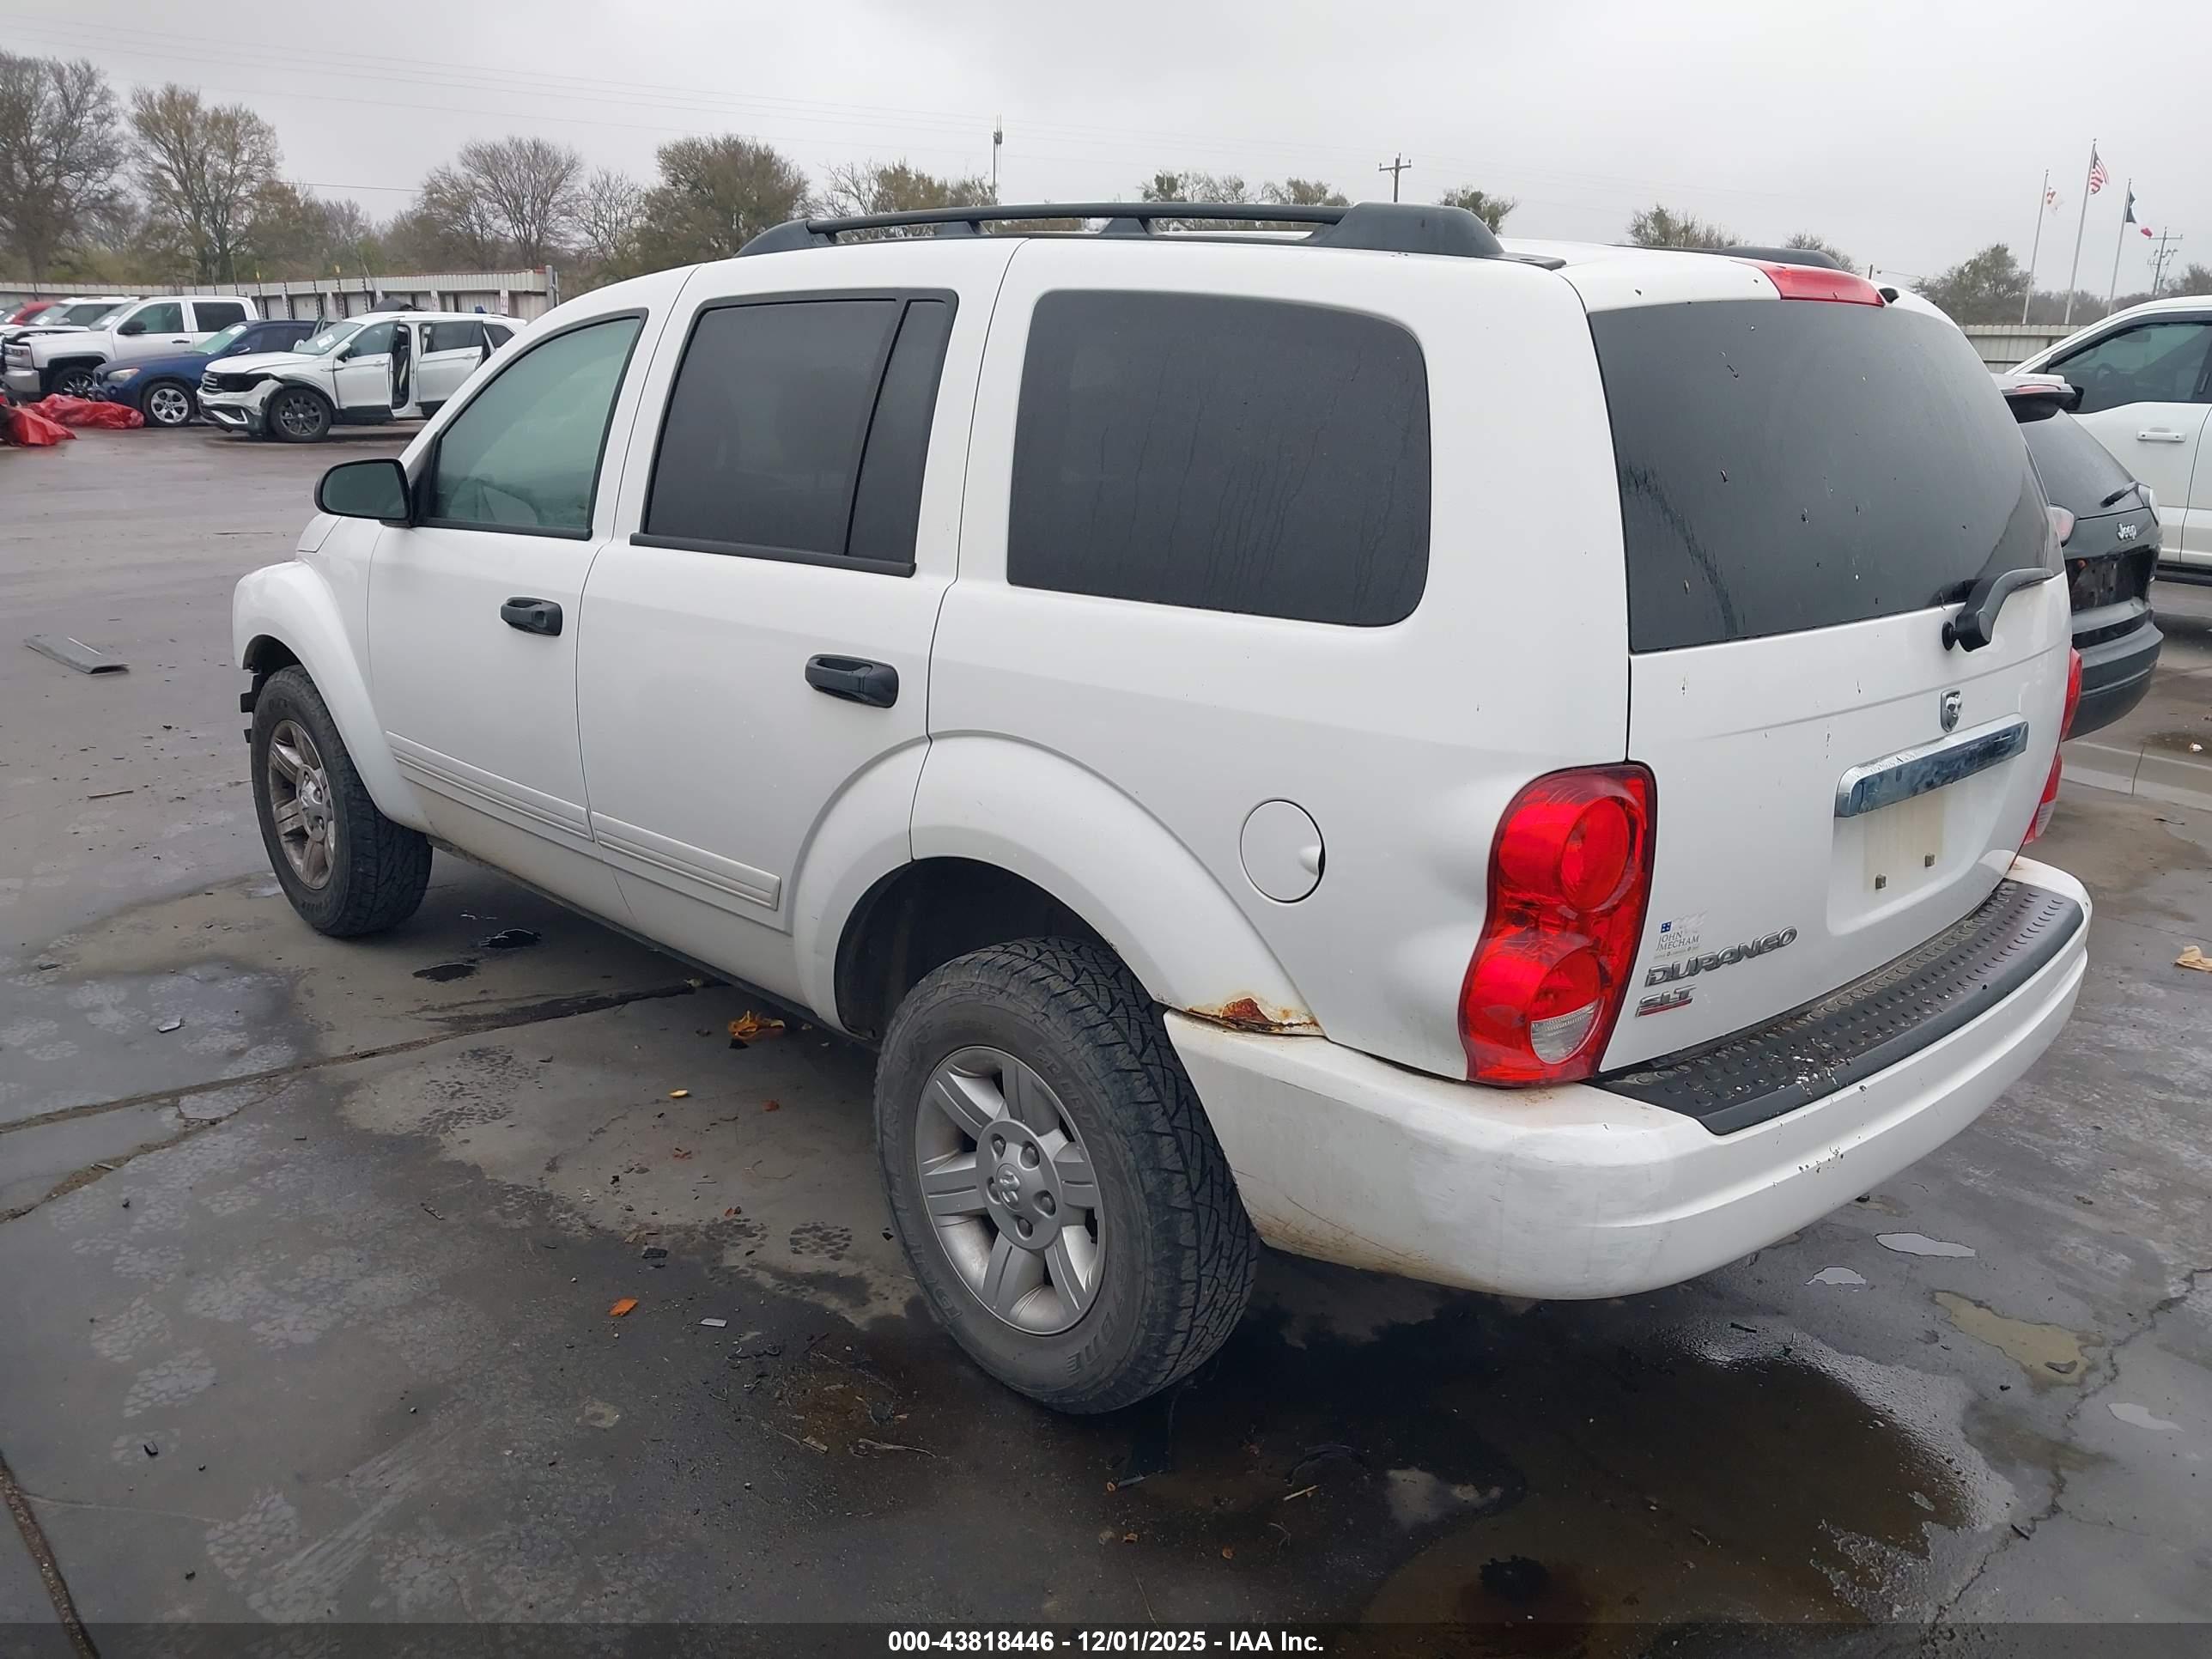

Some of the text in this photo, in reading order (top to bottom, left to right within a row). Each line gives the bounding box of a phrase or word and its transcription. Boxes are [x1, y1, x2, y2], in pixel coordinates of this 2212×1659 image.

[2117, 522, 2136, 541] Jeep
[1656, 931, 1683, 951] JOHN
[1658, 934, 1700, 951] MECHAM
[1644, 926, 1798, 987] DURANGO
[1639, 984, 1697, 1006] SLT
